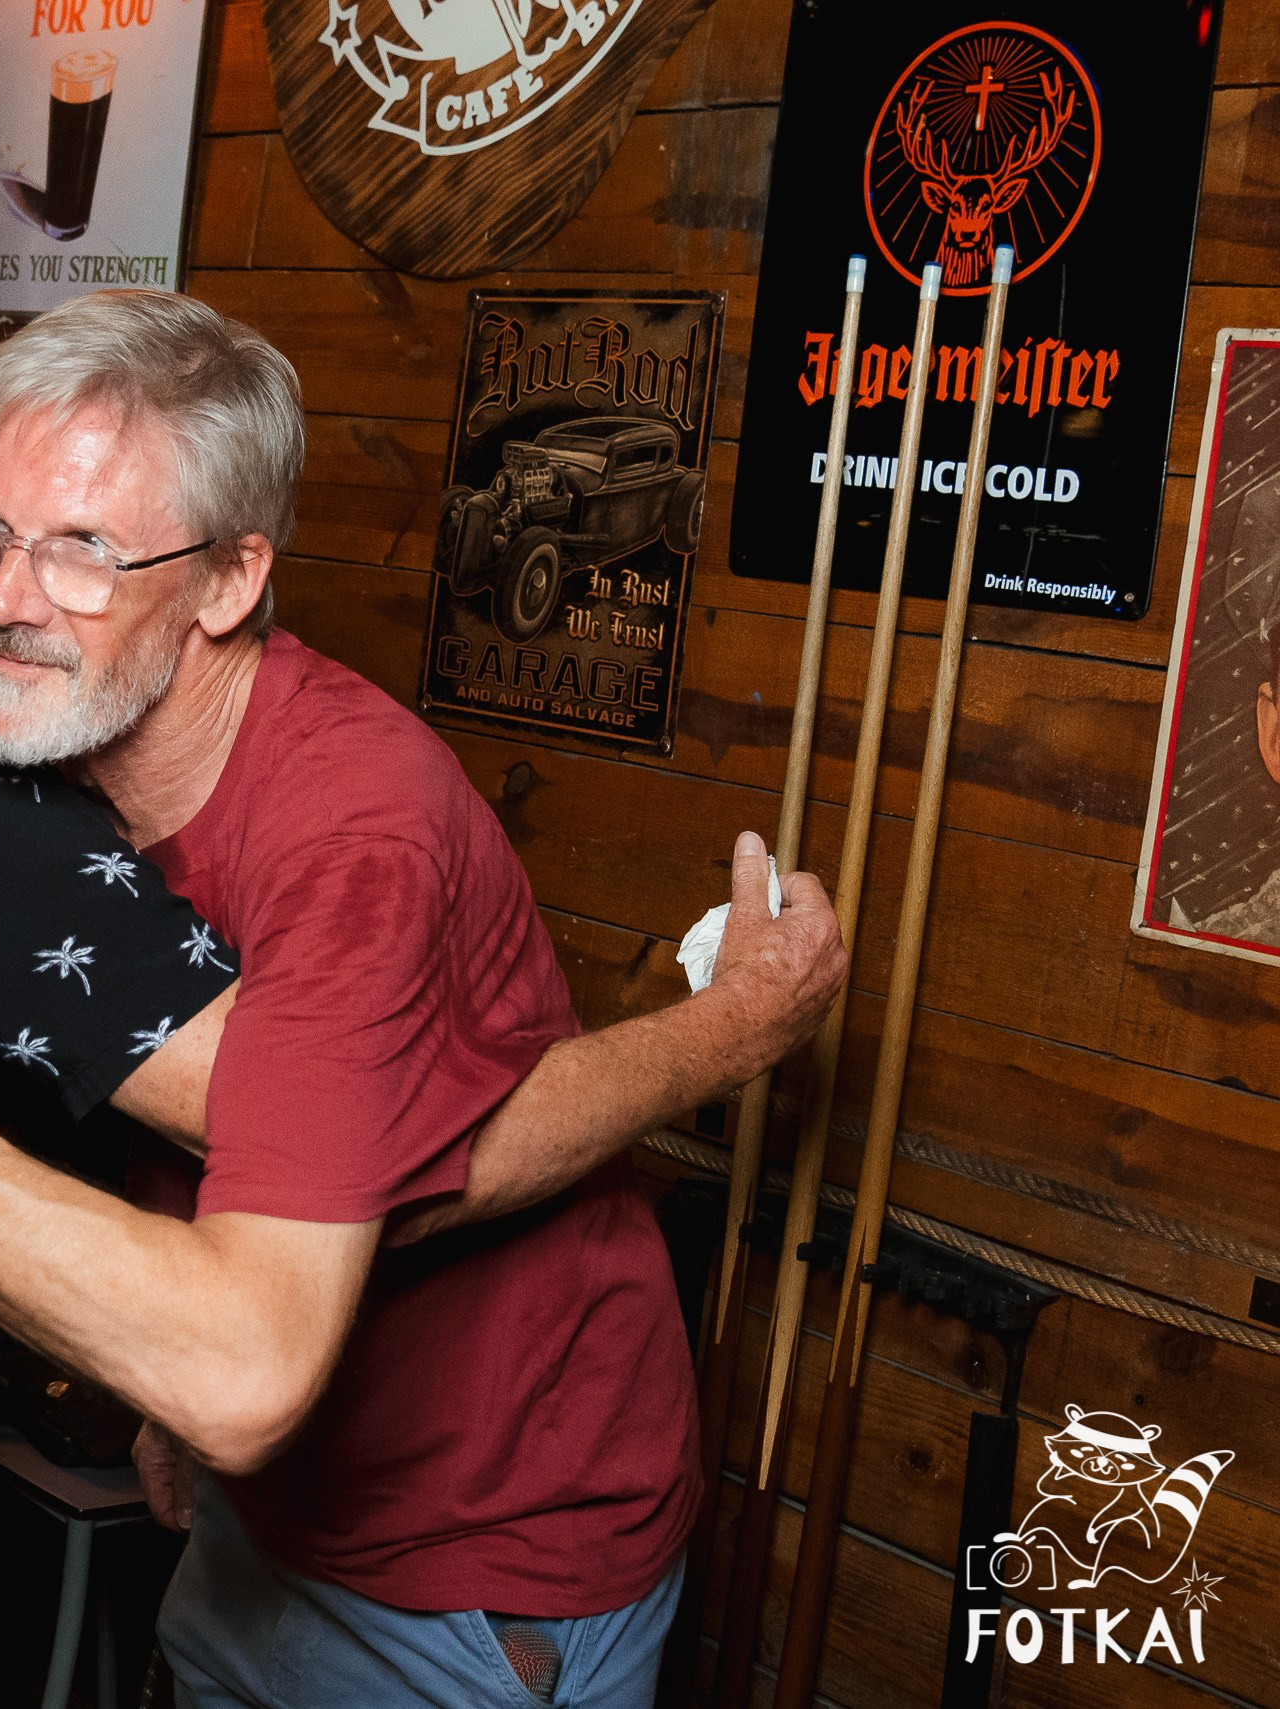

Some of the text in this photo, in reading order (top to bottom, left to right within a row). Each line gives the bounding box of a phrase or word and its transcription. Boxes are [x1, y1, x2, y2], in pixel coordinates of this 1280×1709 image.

[30, 0, 155, 38] FOR YOU
[435, 65, 544, 132] CAFE
[29, 254, 64, 282] YOU
[67, 254, 169, 285] STRENGTH
[466, 311, 700, 438] Rat Rod
[920, 459, 969, 495] ICE
[985, 464, 1080, 503] COLD
[585, 564, 671, 607] In Rust
[984, 572, 1117, 605] Drink Responsibly
[565, 604, 665, 651] We Trust
[436, 635, 663, 712] GARAGE
[456, 685, 636, 728] AND AUTO SALVAGE
